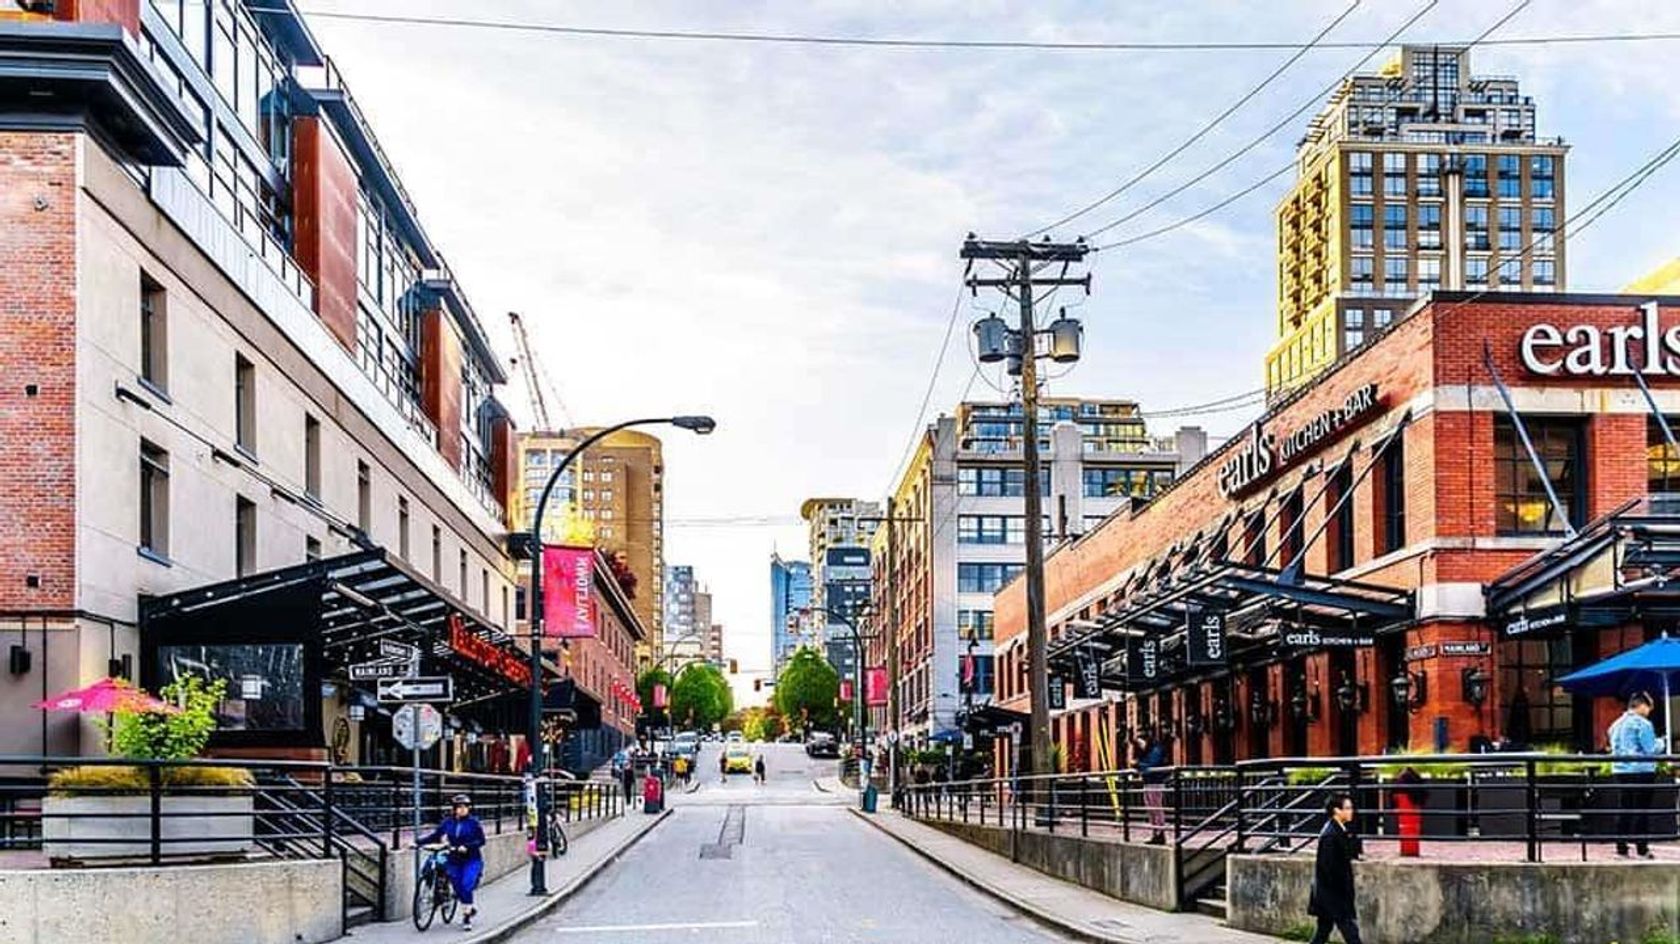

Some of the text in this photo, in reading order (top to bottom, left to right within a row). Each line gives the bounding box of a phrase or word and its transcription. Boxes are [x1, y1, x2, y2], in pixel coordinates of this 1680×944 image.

[1217, 423, 1270, 498] earls
[1279, 410, 1331, 462] KITCHEN
[1343, 383, 1374, 422] BAR
[1202, 615, 1221, 659] earls
[1286, 629, 1321, 645] earls
[1139, 640, 1156, 678] earls
[1083, 663, 1098, 696] earls
